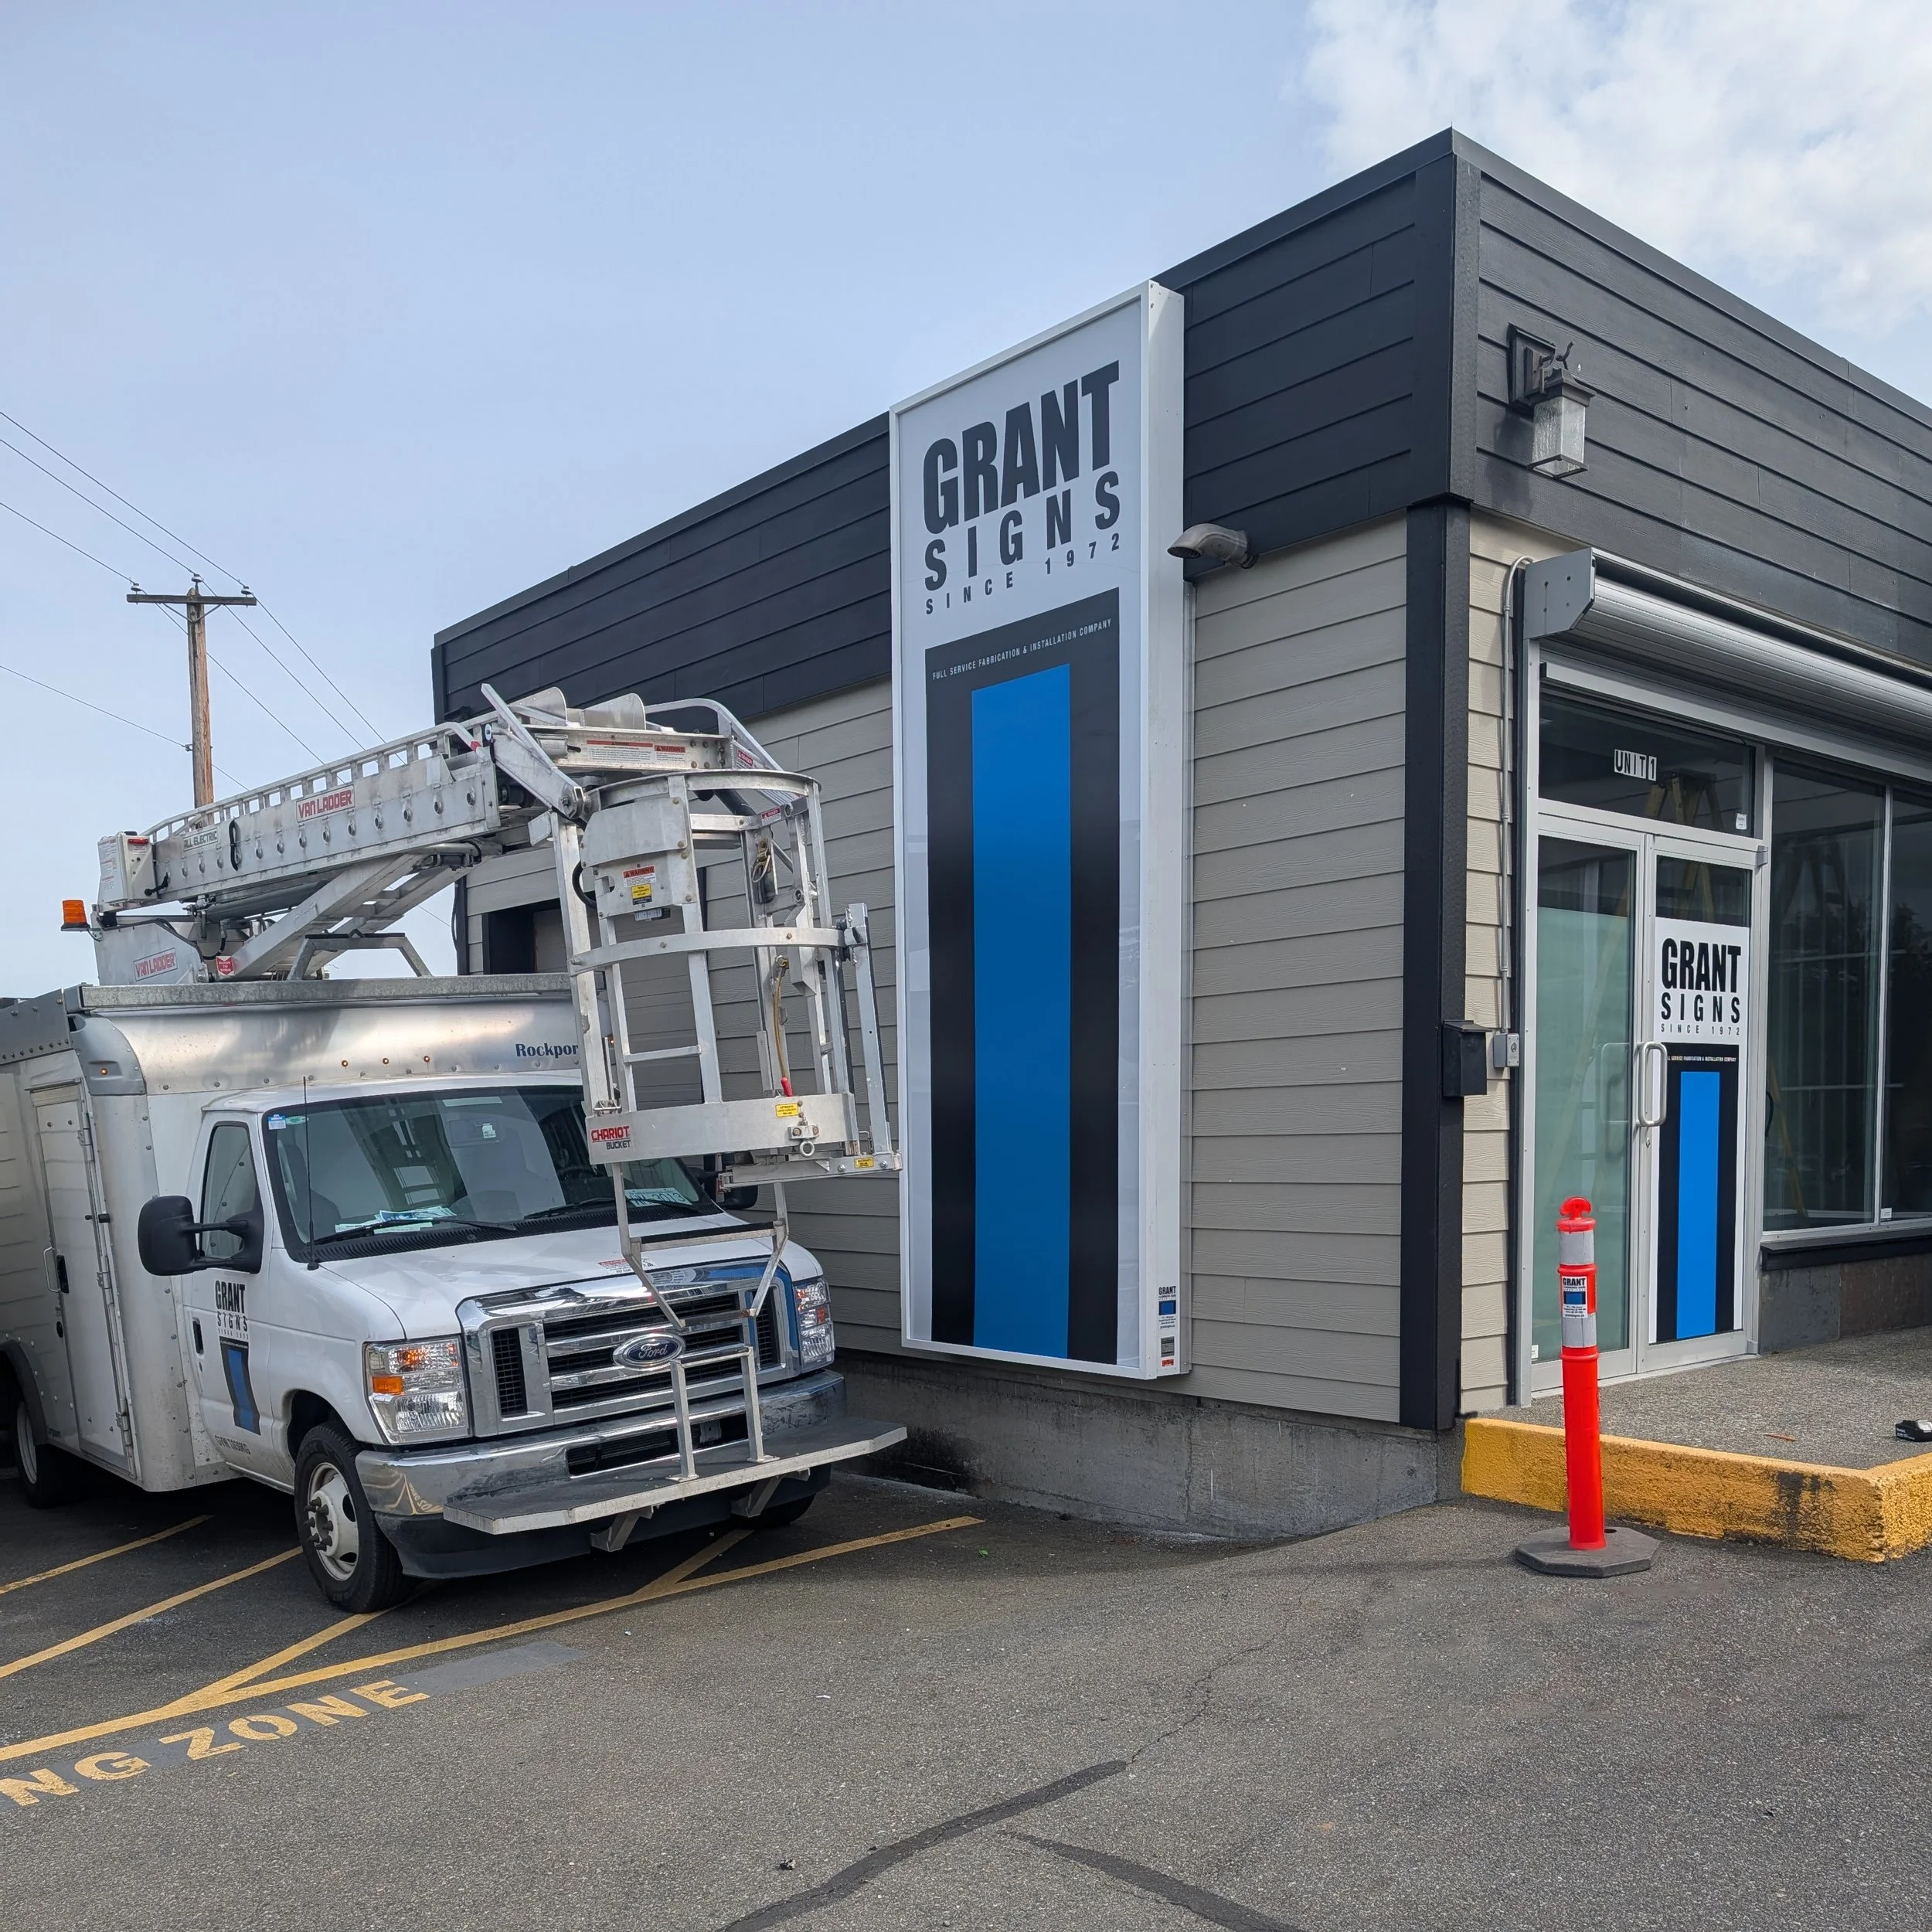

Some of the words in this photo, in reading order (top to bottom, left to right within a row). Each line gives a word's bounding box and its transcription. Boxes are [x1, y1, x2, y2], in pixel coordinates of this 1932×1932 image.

[923, 359, 1119, 534] GRANT
[924, 471, 1120, 591] SIGNS
[926, 571, 1013, 615] SINCE
[1045, 532, 1120, 575] 1972
[932, 669, 947, 680] FULL
[950, 660, 976, 675] SERVICE
[978, 648, 1020, 668] FABRICATION
[1022, 645, 1028, 654] &
[1029, 630, 1077, 651] INSTALLATION
[1079, 618, 1111, 636] COMPANY
[1615, 750, 1646, 777] UNIT
[1650, 758, 1655, 779] 1
[298, 801, 316, 818] VAN
[317, 790, 352, 814] LADDER
[193, 830, 217, 846] ELECTRIC
[135, 961, 149, 977] VAN
[149, 953, 175, 973] LADDER
[1662, 937, 1741, 993] GRANT
[1661, 992, 1740, 1023] SIGNS
[1661, 1023, 1699, 1033] SINCE
[1712, 1026, 1740, 1036] 1972
[515, 1043, 578, 1059] Rockpor
[591, 1126, 630, 1141] CHARIOT
[606, 1140, 631, 1150] BUCKET
[1158, 1286, 1176, 1295] GRANT
[1563, 1277, 1586, 1286] GRANT
[216, 1280, 246, 1314] GRANT
[217, 1311, 248, 1332] SIGNS
[638, 1342, 668, 1359] Ford
[0, 1751, 152, 1807] NG
[158, 1680, 430, 1760] ZONE
